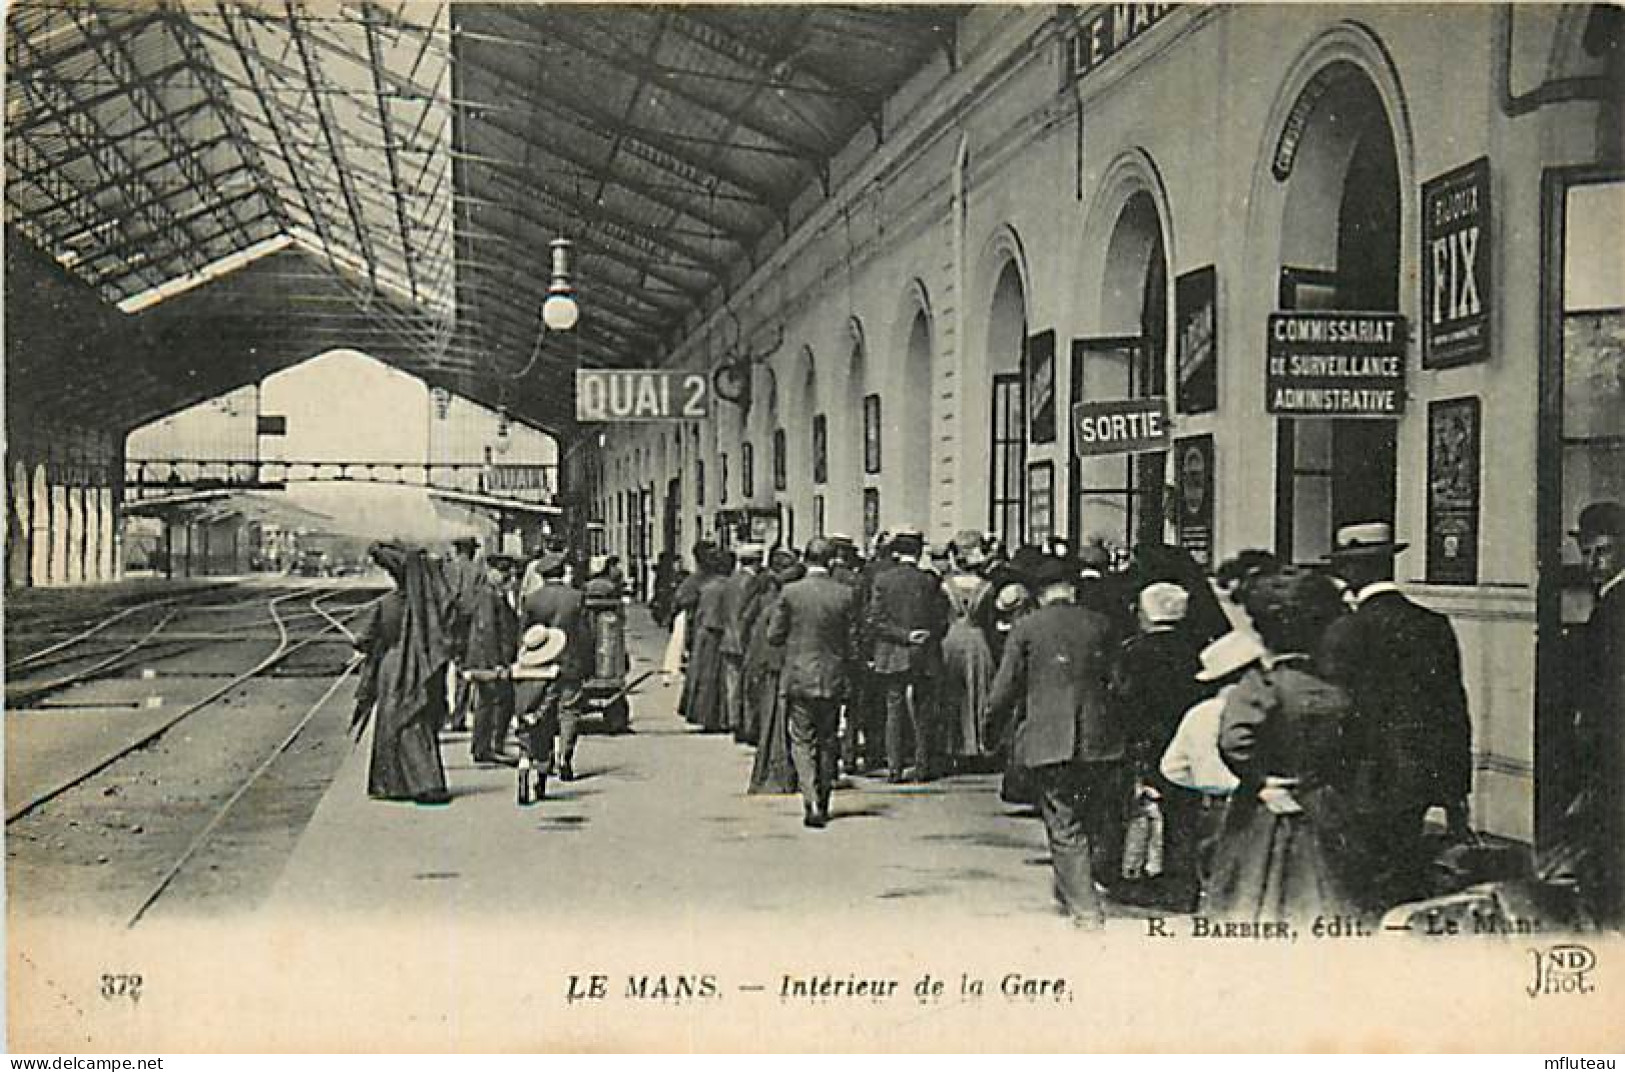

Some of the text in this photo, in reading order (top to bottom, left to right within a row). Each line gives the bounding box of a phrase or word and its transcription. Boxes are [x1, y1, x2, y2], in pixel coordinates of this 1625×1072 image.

[1075, 17, 1104, 75] LE
[1433, 226, 1481, 325] FIX
[1275, 319, 1396, 343] COMMISSARIAT
[1290, 355, 1401, 377] SURVEILLANCE
[582, 374, 707, 417] QUAI 2
[1274, 388, 1397, 411] ADMINISTRATIVE
[1081, 411, 1164, 442] SORTIE
